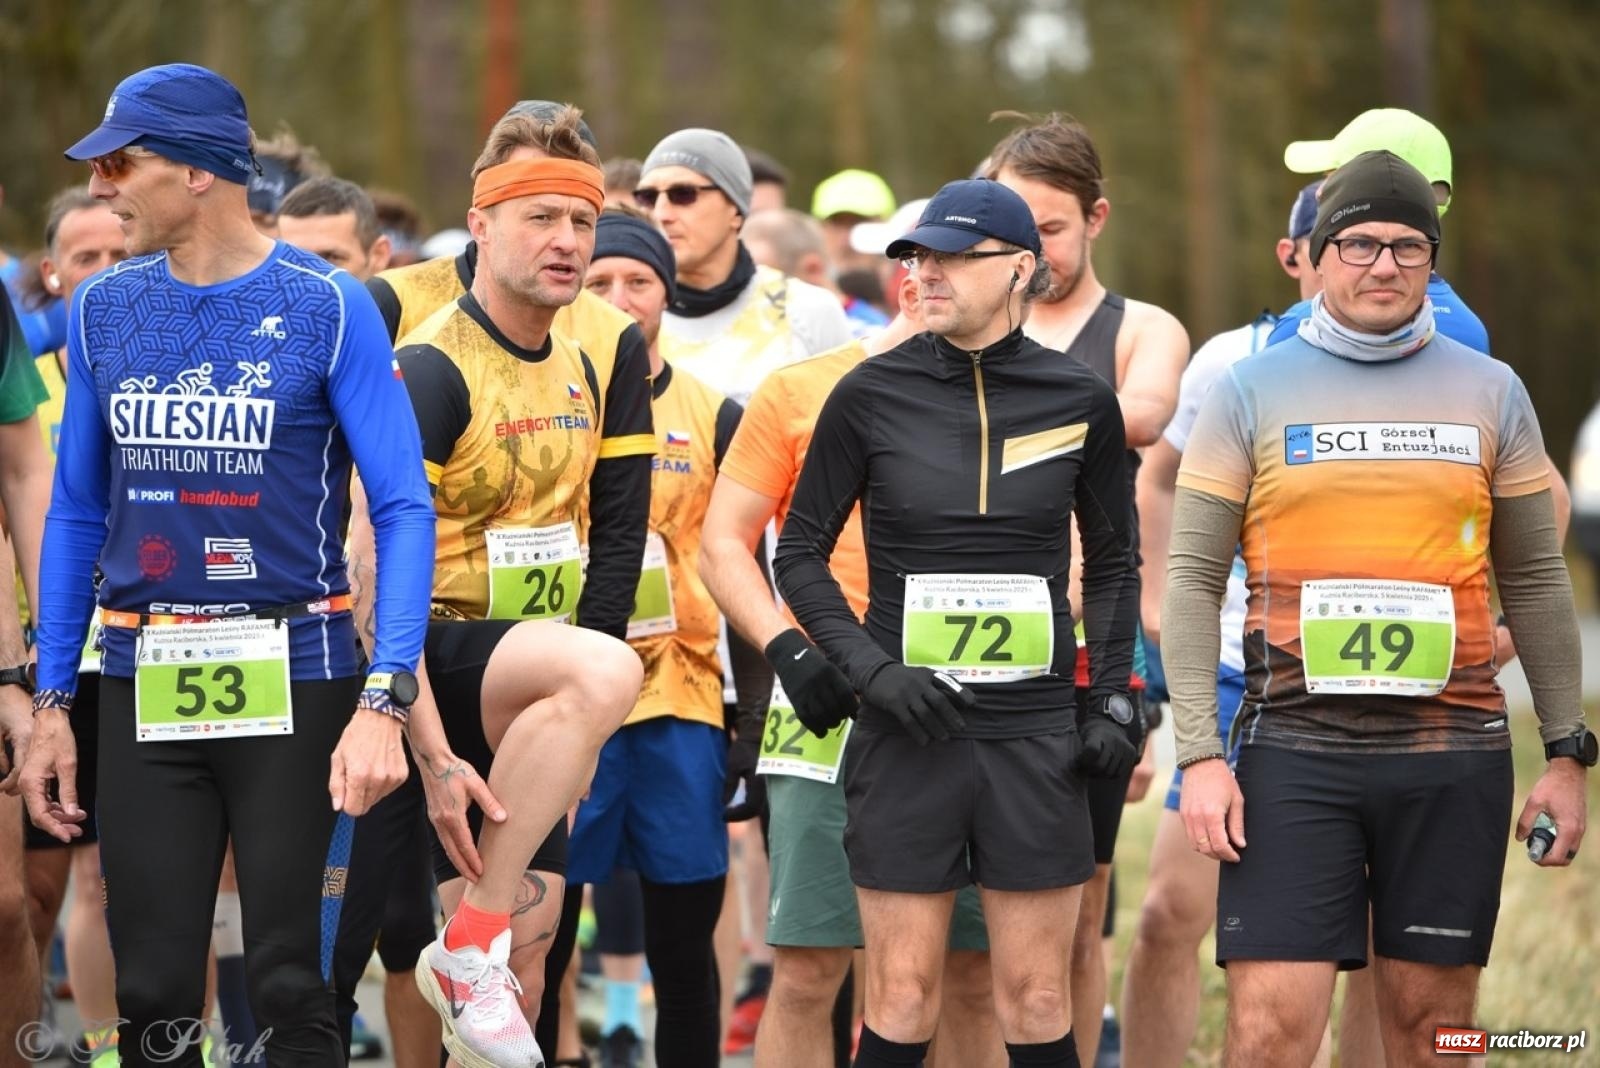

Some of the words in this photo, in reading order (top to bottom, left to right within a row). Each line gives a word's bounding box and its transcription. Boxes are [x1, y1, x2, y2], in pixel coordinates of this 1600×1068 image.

[114, 398, 268, 444] SILESIAN
[1316, 431, 1368, 453] SCI
[121, 448, 208, 473] TRIATHLON
[214, 451, 264, 474] TEAM
[1383, 442, 1471, 455] Entuzjaści
[180, 489, 260, 506] handlobud
[521, 565, 565, 615] 26
[944, 615, 1012, 662] 72
[1339, 622, 1415, 672] 49
[175, 664, 247, 717] 53
